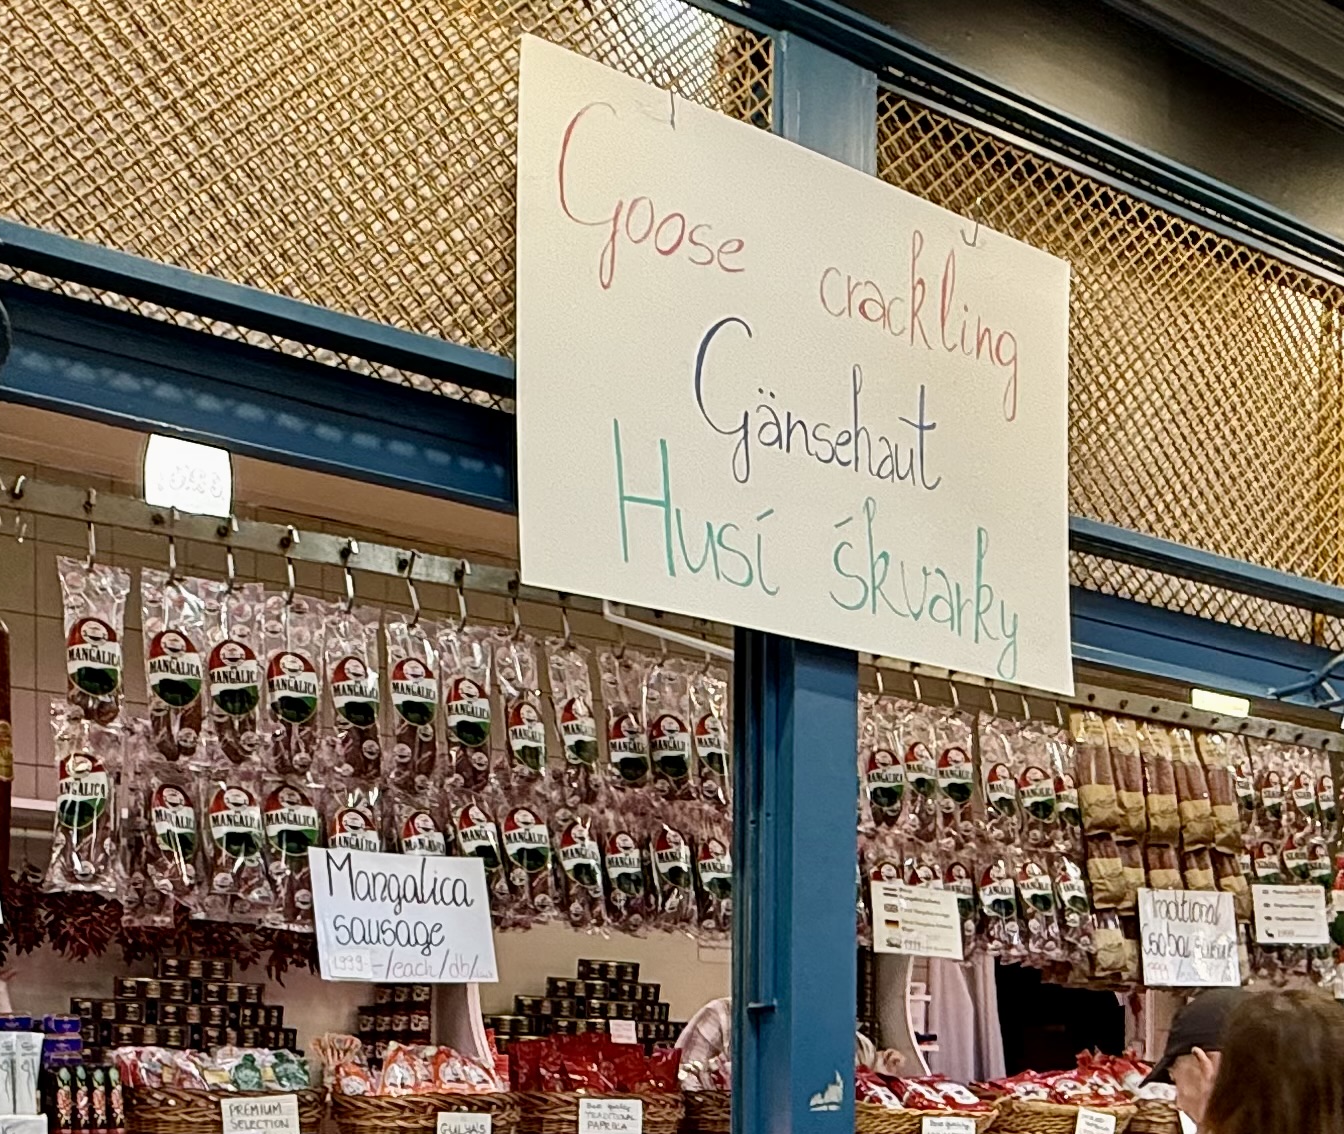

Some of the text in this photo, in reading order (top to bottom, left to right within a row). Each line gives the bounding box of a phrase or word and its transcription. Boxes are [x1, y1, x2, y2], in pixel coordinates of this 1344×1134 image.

[559, 101, 1019, 421] Goose crackling
[694, 316, 942, 490] Gänsehaut
[614, 418, 780, 596] Husí
[326, 850, 474, 916] Mangalica
[333, 914, 446, 956] sausage
[228, 1102, 282, 1117] PREMIUM
[229, 1118, 290, 1130] SELECTION
